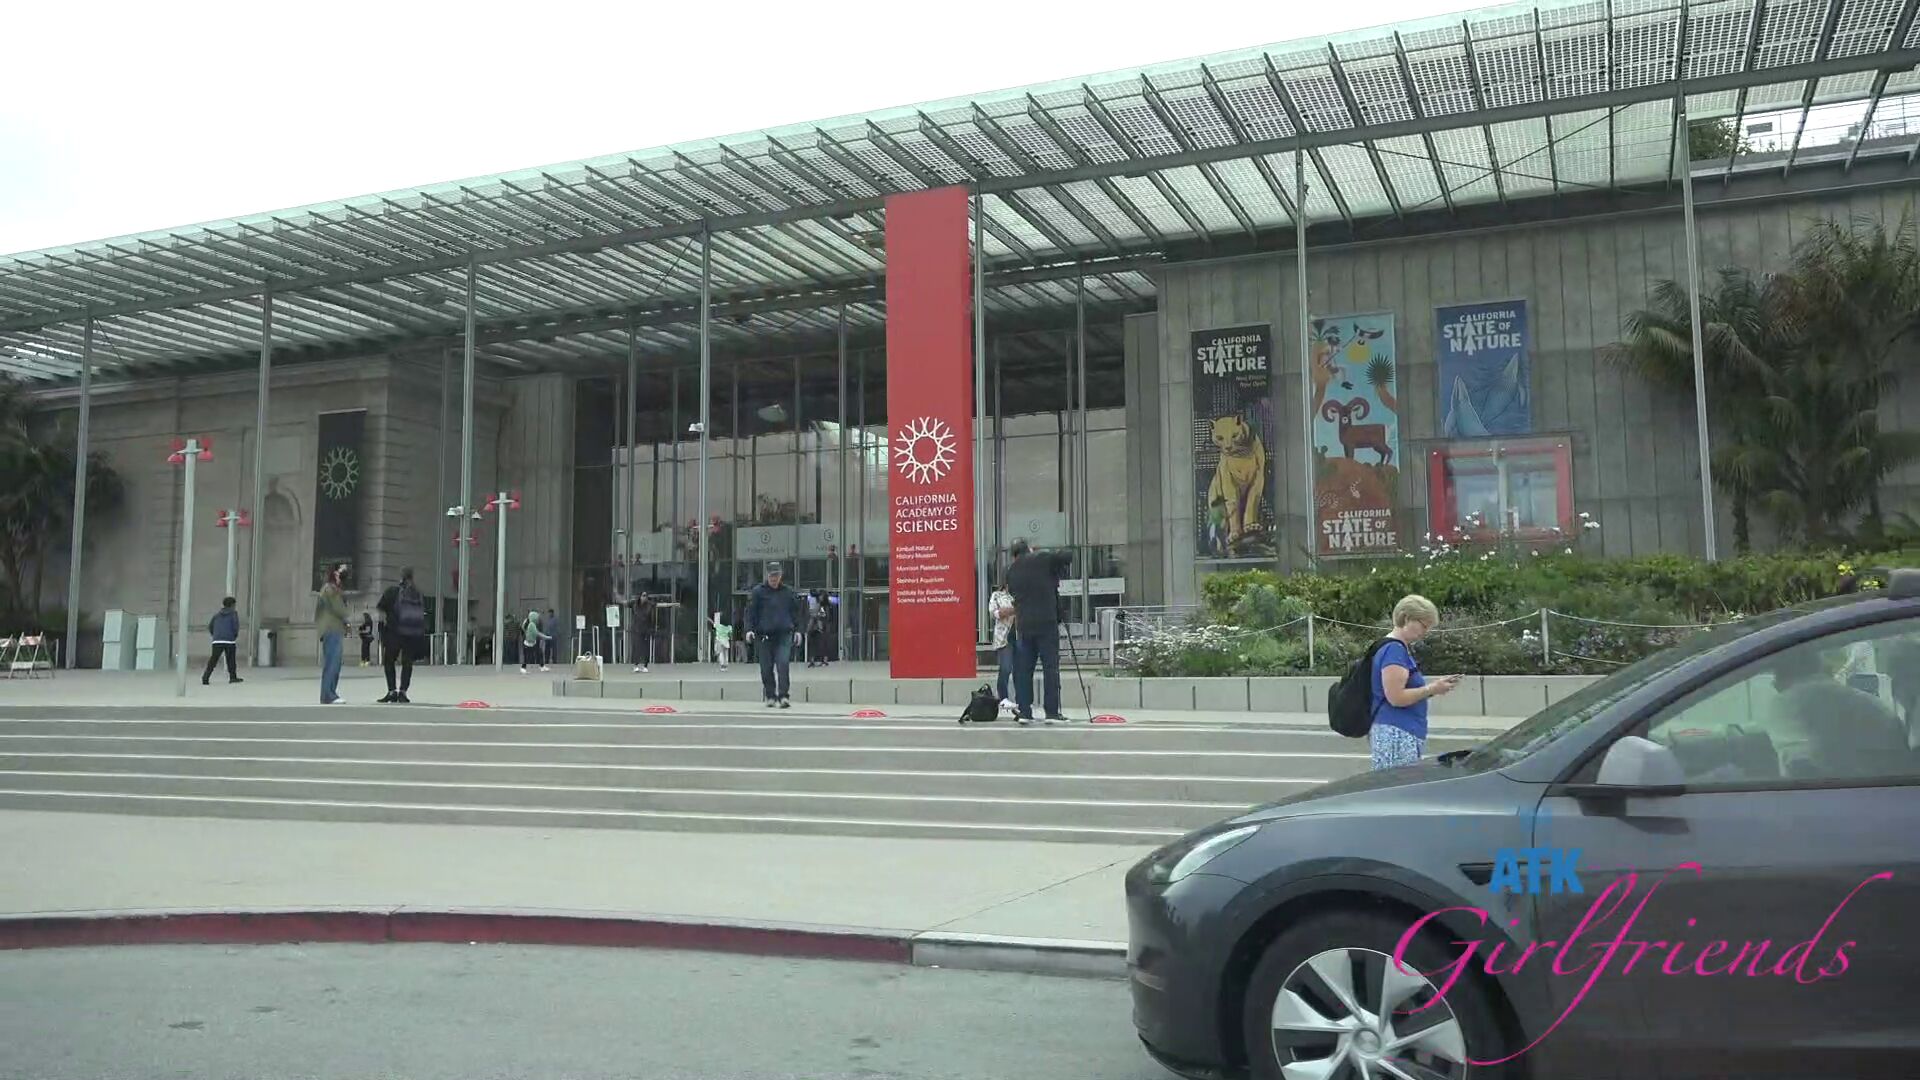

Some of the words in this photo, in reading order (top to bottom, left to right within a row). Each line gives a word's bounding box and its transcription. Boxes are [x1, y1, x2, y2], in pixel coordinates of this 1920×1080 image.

[1460, 310, 1516, 323] CALIFORNIA
[1443, 320, 1497, 339] STATE
[1498, 321, 1511, 331] OF
[1212, 334, 1262, 346] CALIFORNIA
[1450, 333, 1522, 355] NATURE
[1197, 344, 1244, 361] STATE
[1246, 345, 1258, 354] OF
[1203, 356, 1267, 377] NATURE
[895, 493, 957, 506] CALIFORNIA
[895, 506, 943, 519] ACADEMY
[944, 505, 958, 516] OF
[1337, 508, 1391, 519] CALIFORNIA
[895, 518, 958, 533] SCIENCES
[1322, 518, 1372, 534] STATE
[1374, 520, 1387, 529] OF
[1328, 531, 1397, 552] NATURE
